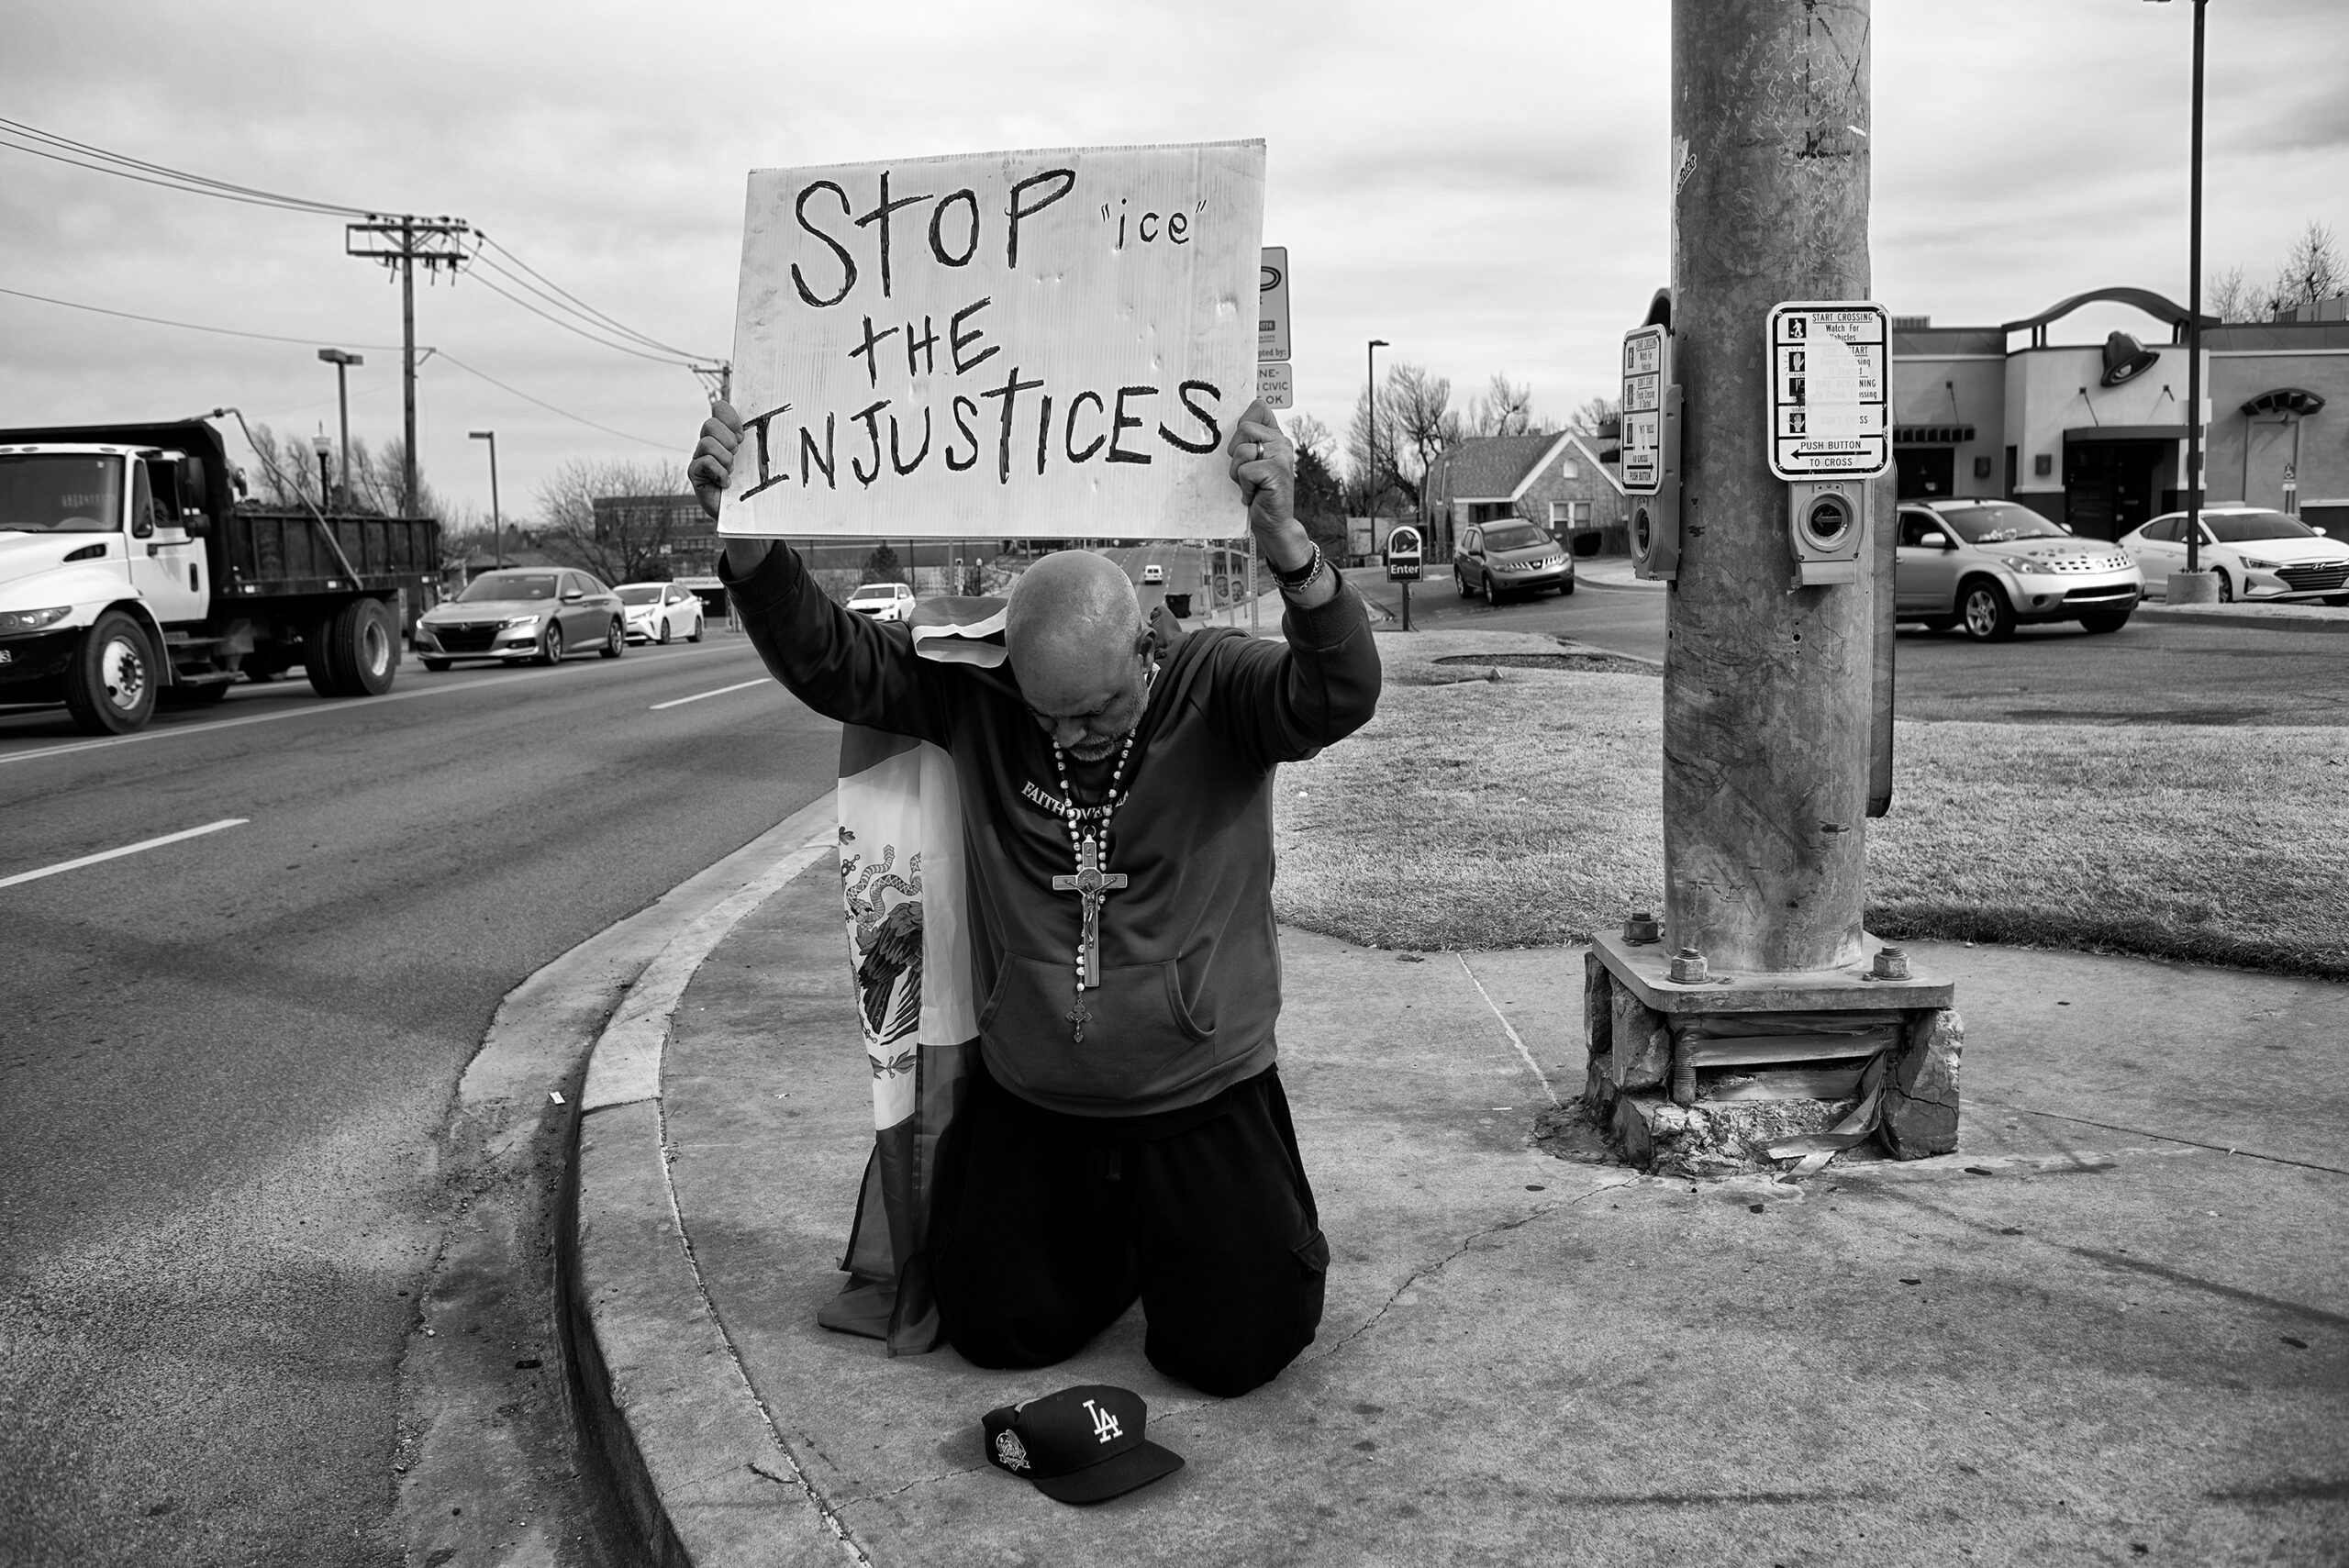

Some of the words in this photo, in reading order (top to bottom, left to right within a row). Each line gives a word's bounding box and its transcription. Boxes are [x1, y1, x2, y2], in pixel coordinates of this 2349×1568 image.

[1837, 313, 1873, 321] CROSSING
[1826, 324, 1845, 332] Watch
[1849, 324, 1860, 332] For
[1258, 349, 1274, 359] pted
[1260, 369, 1279, 377] NE-
[1263, 382, 1288, 391] CIVIC
[1266, 395, 1283, 404] OK
[1800, 441, 1824, 450] PUSH
[1828, 440, 1861, 450] BUTTON
[1809, 459, 1820, 467] TO
[1824, 458, 1853, 467] CROSS
[1391, 564, 1419, 574] Enter
[1020, 781, 1065, 816] FAITH
[1082, 1399, 1123, 1443] LA
